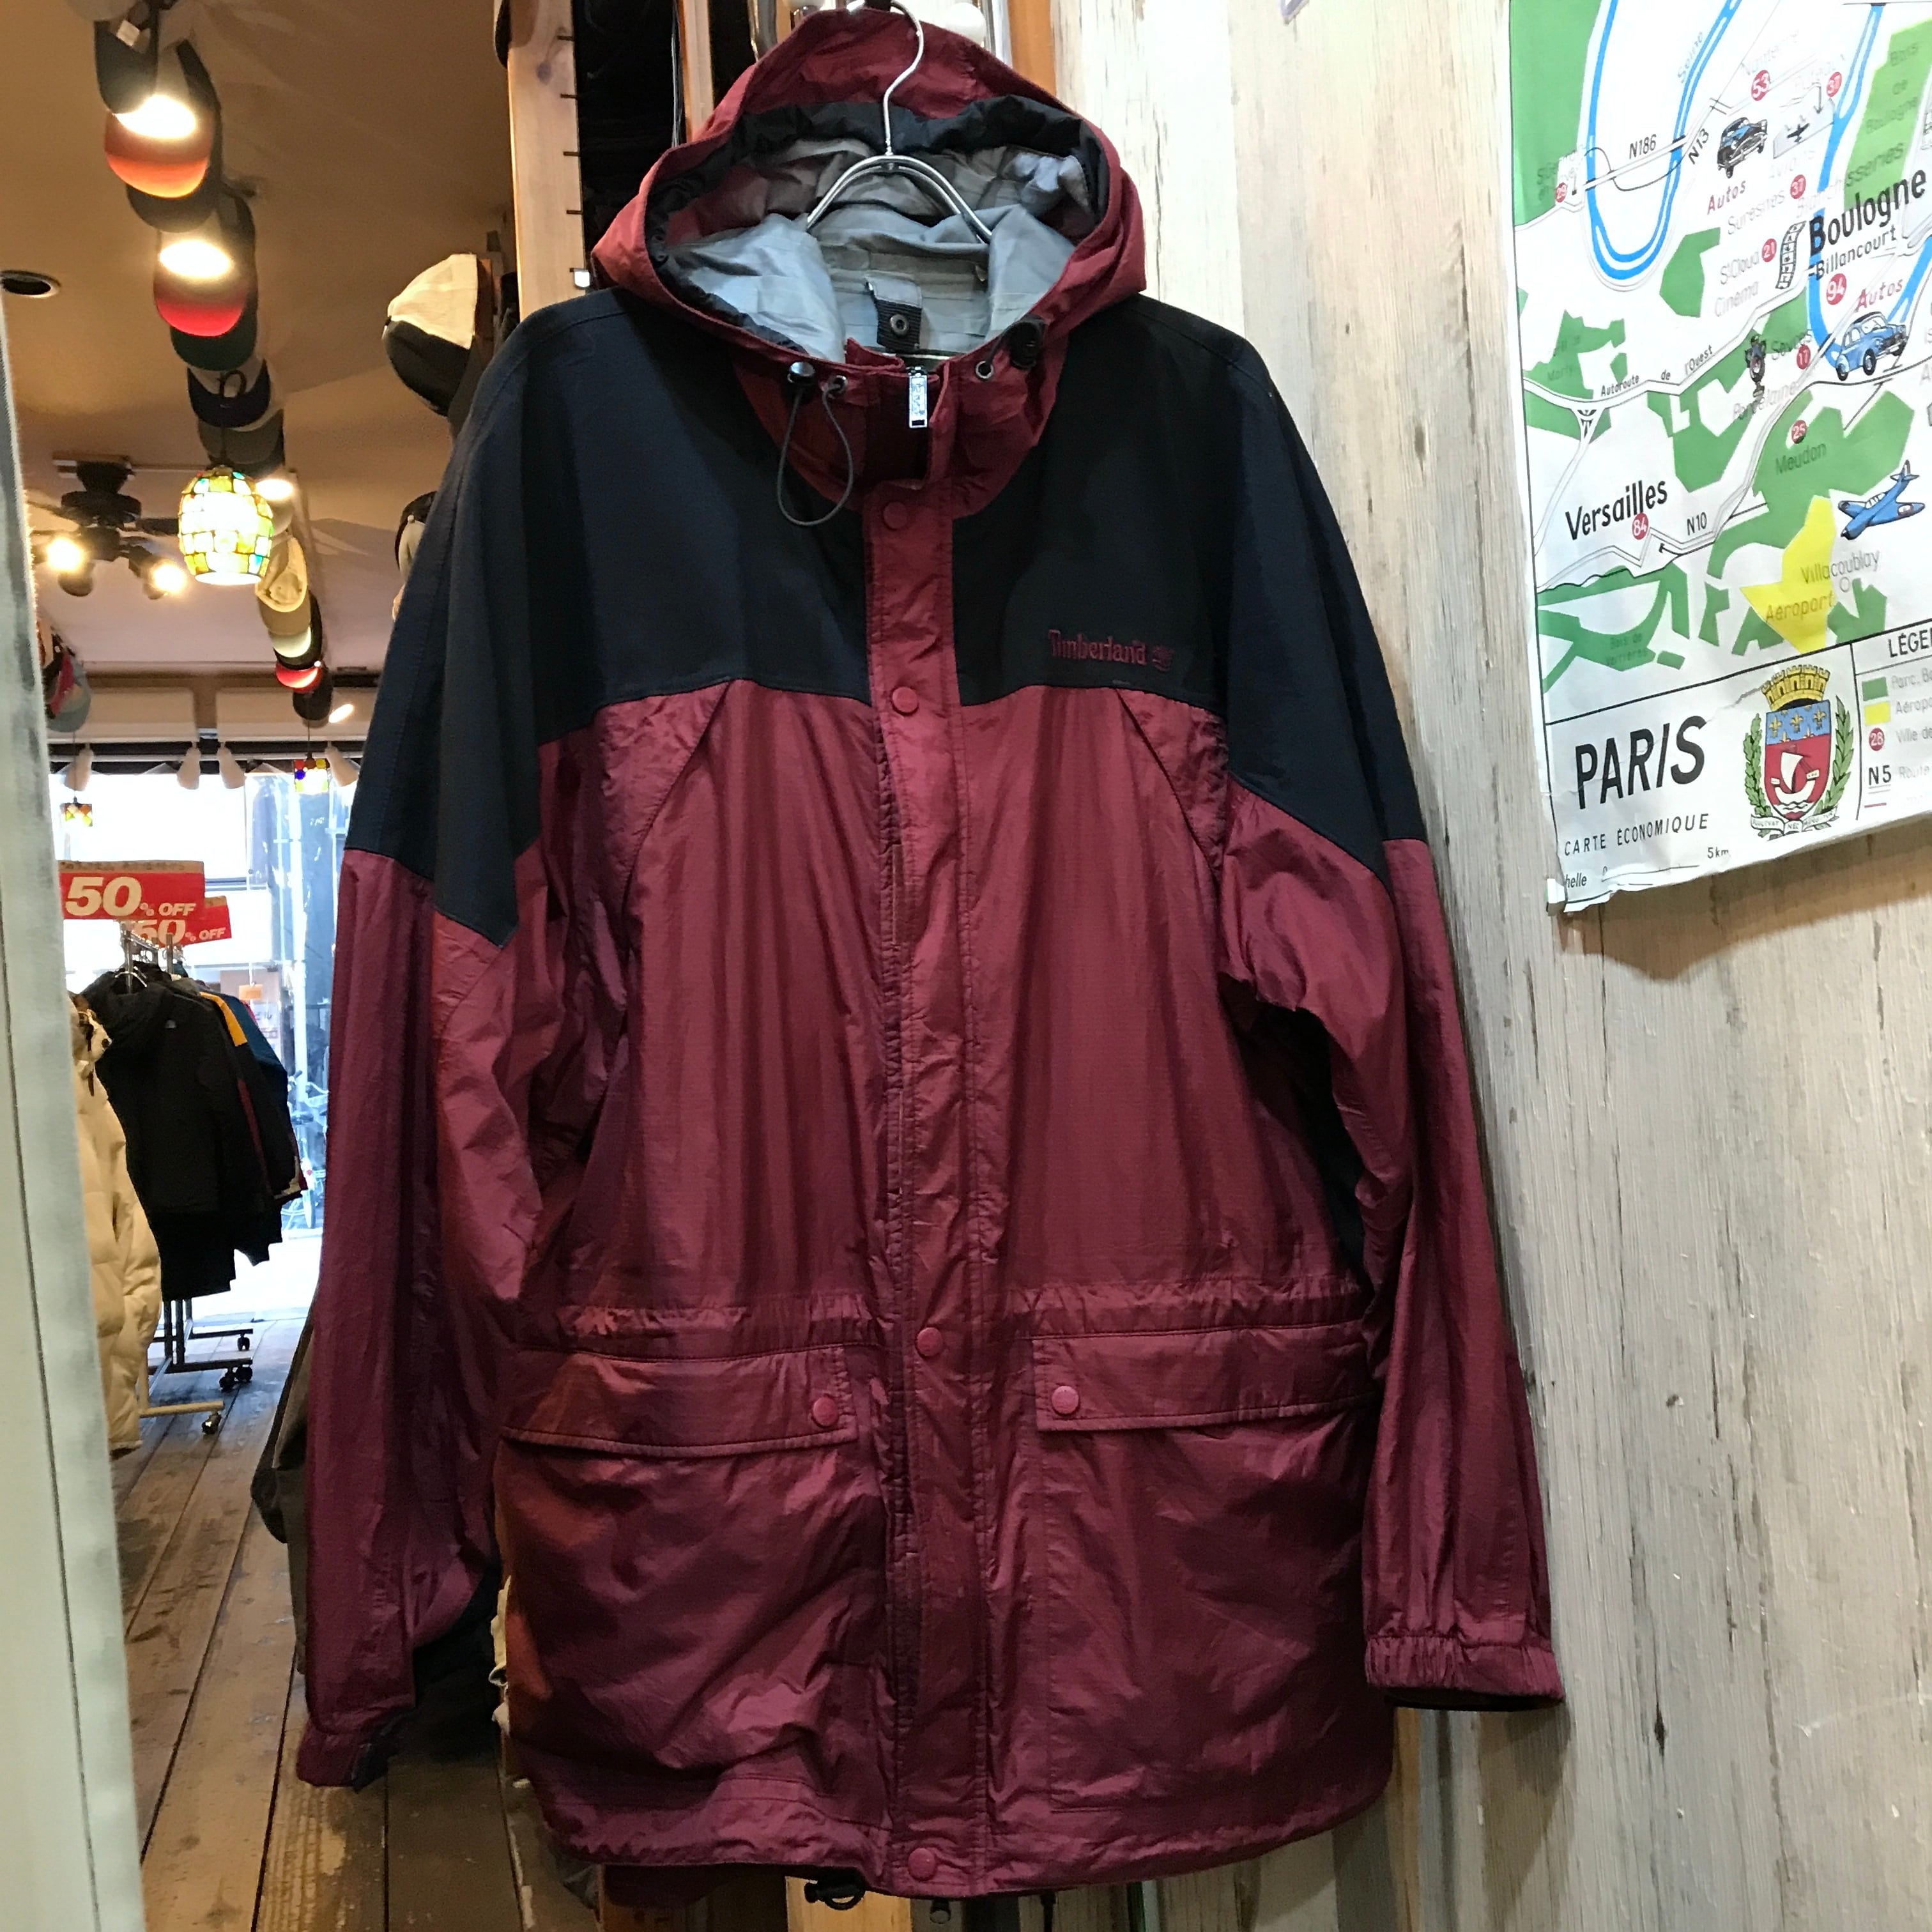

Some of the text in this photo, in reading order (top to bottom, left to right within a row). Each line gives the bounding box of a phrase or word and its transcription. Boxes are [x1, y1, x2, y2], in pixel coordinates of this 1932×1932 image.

[1752, 72, 1770, 98] 53
[1629, 134, 1657, 160] N186
[1687, 128, 1710, 165] N13
[1706, 180, 1747, 215] Autos
[1809, 167, 1926, 259] Boulogne
[1763, 241, 1776, 259] 21
[1816, 224, 1897, 282] Billancourt
[1826, 275, 1846, 303] 94
[1854, 278, 1903, 314] Autos
[1600, 374, 1640, 397] Autoroute
[1660, 369, 1671, 382] de
[1565, 480, 1667, 540] Versailles
[1633, 517, 1647, 536] 84
[1800, 549, 1881, 585] Villacoublay
[1048, 628, 1147, 666] Timberland
[1869, 731, 1884, 747] 28
[1574, 714, 1708, 811] PARIS
[1565, 813, 1709, 856] CARTE ÉCONOMIQUE
[158, 902, 197, 916] OFF
[199, 927, 226, 940] OFF
